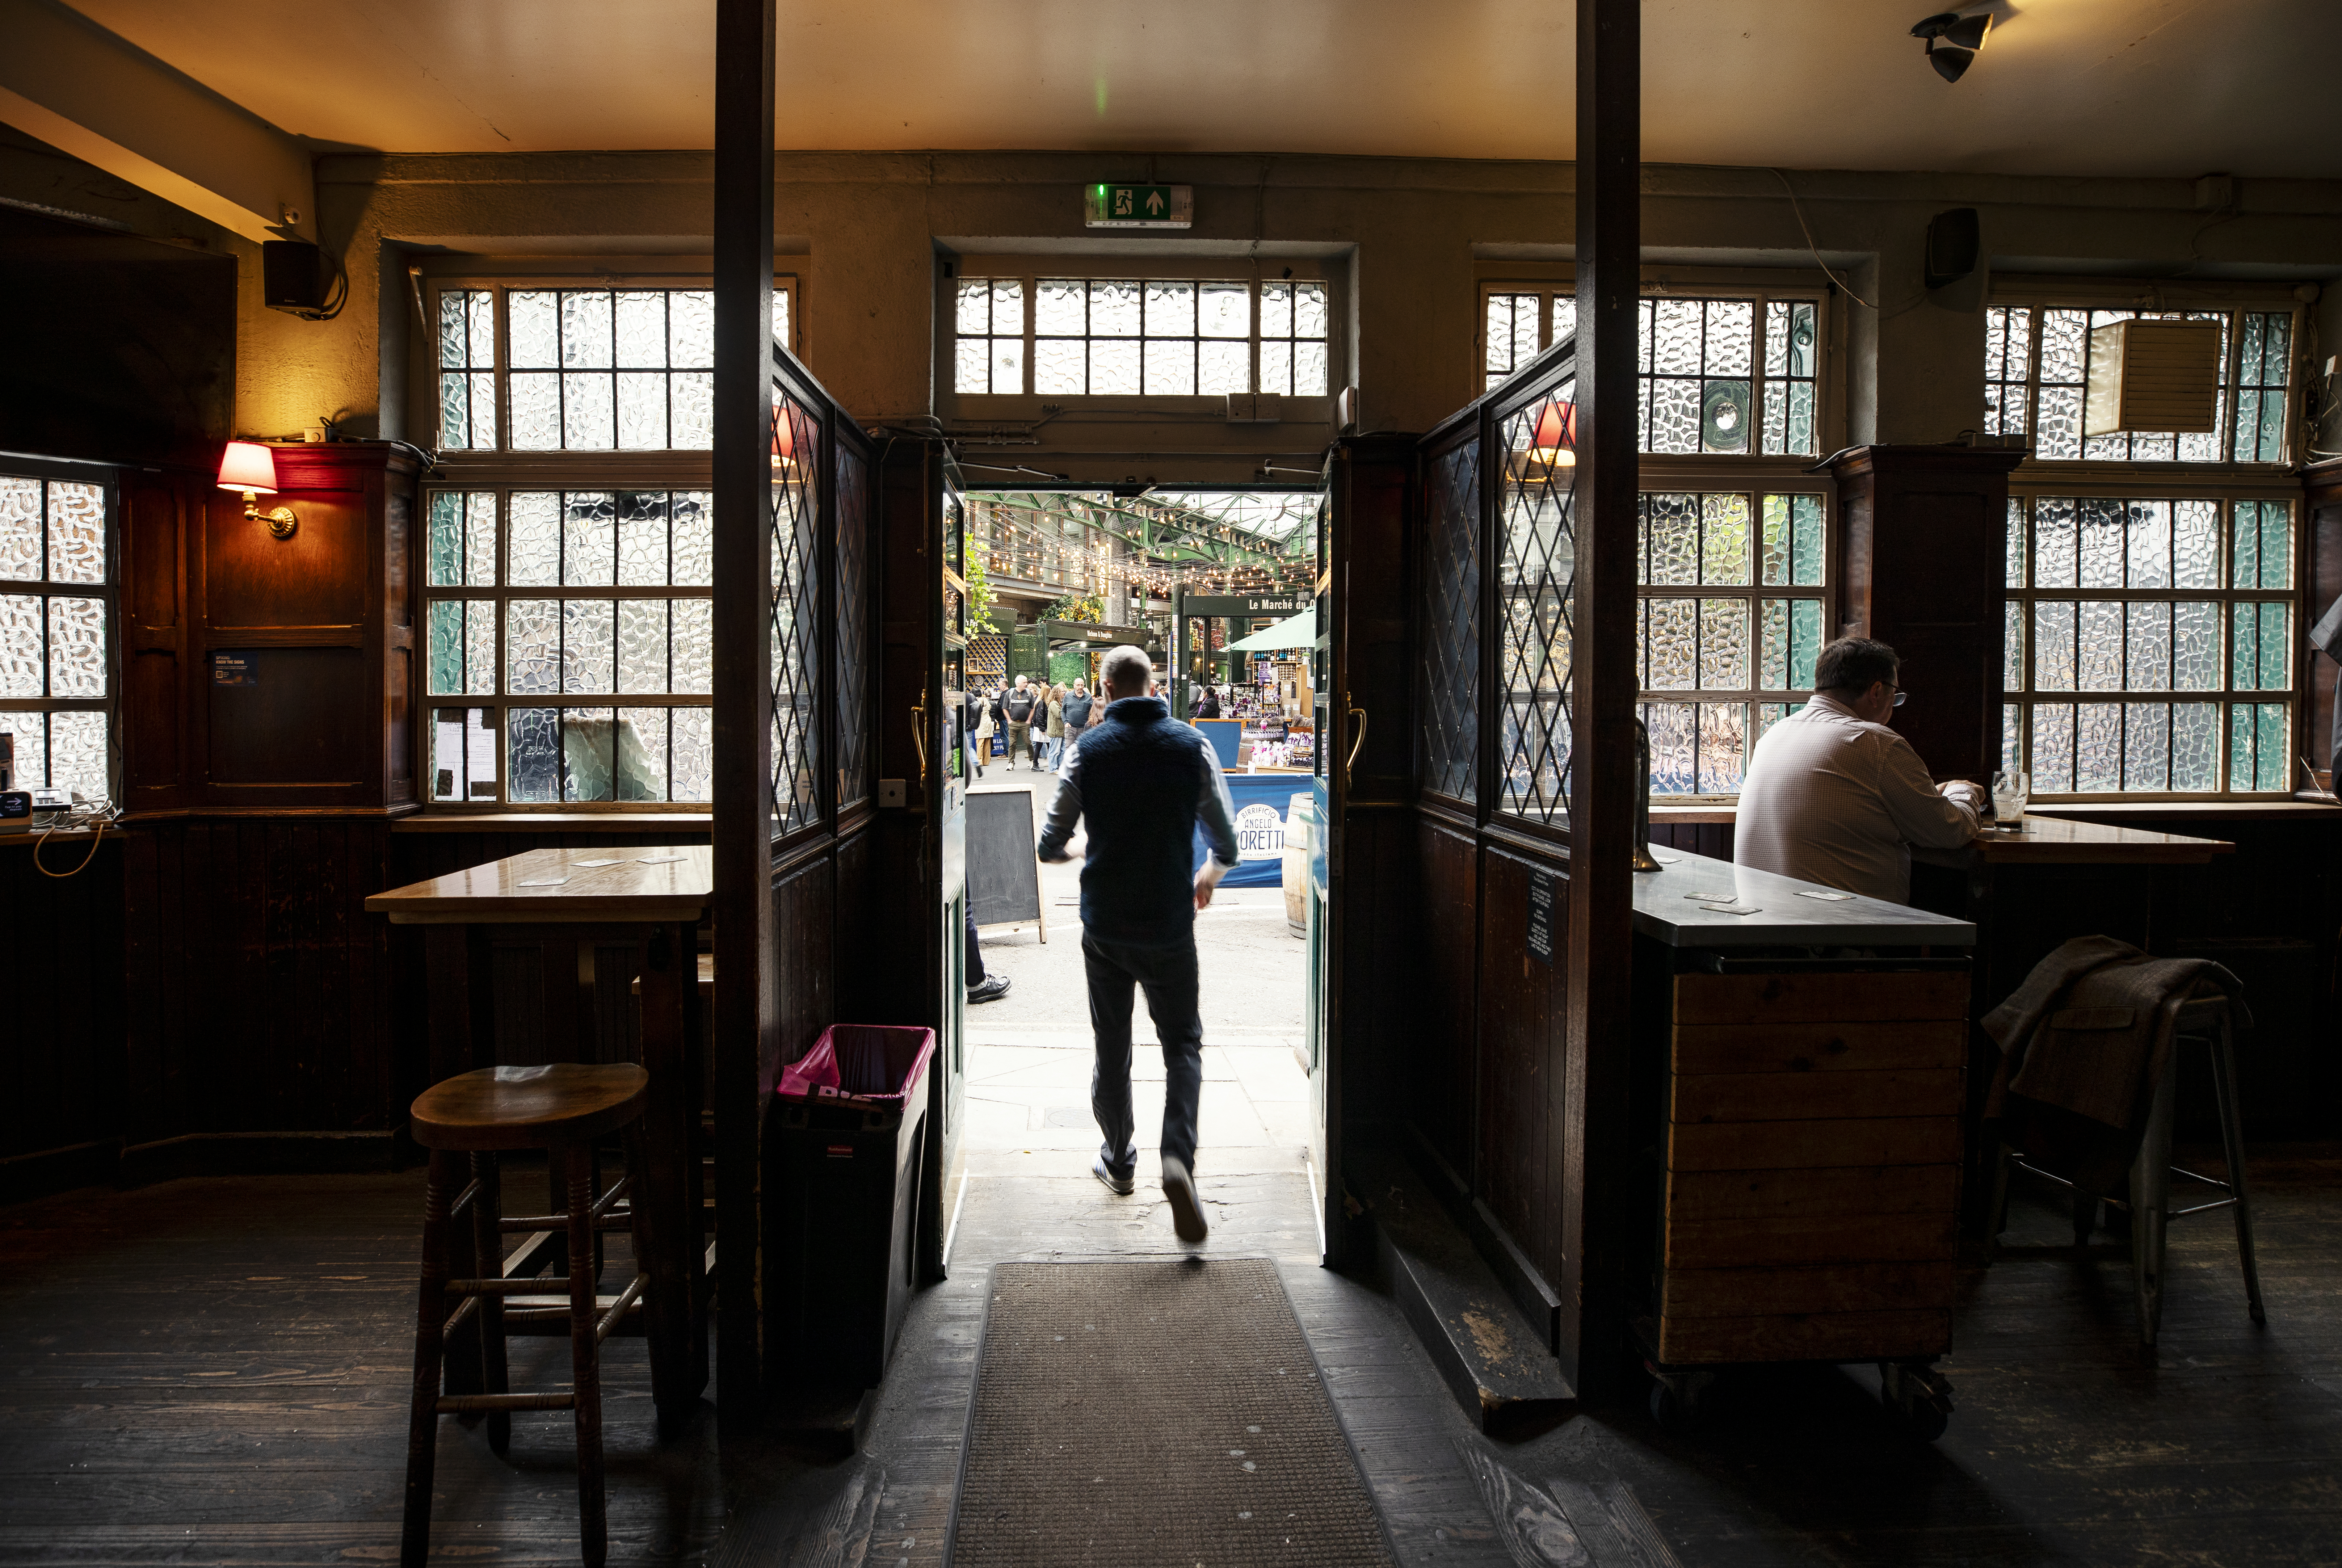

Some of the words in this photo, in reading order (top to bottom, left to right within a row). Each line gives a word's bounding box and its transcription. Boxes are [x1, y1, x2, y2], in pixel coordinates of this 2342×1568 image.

[1249, 599, 1258, 610] Le
[1262, 599, 1292, 610] Marché
[1296, 600, 1306, 609] du
[1241, 807, 1276, 819] BIRRIFICIO
[1245, 819, 1271, 829] ANGELO
